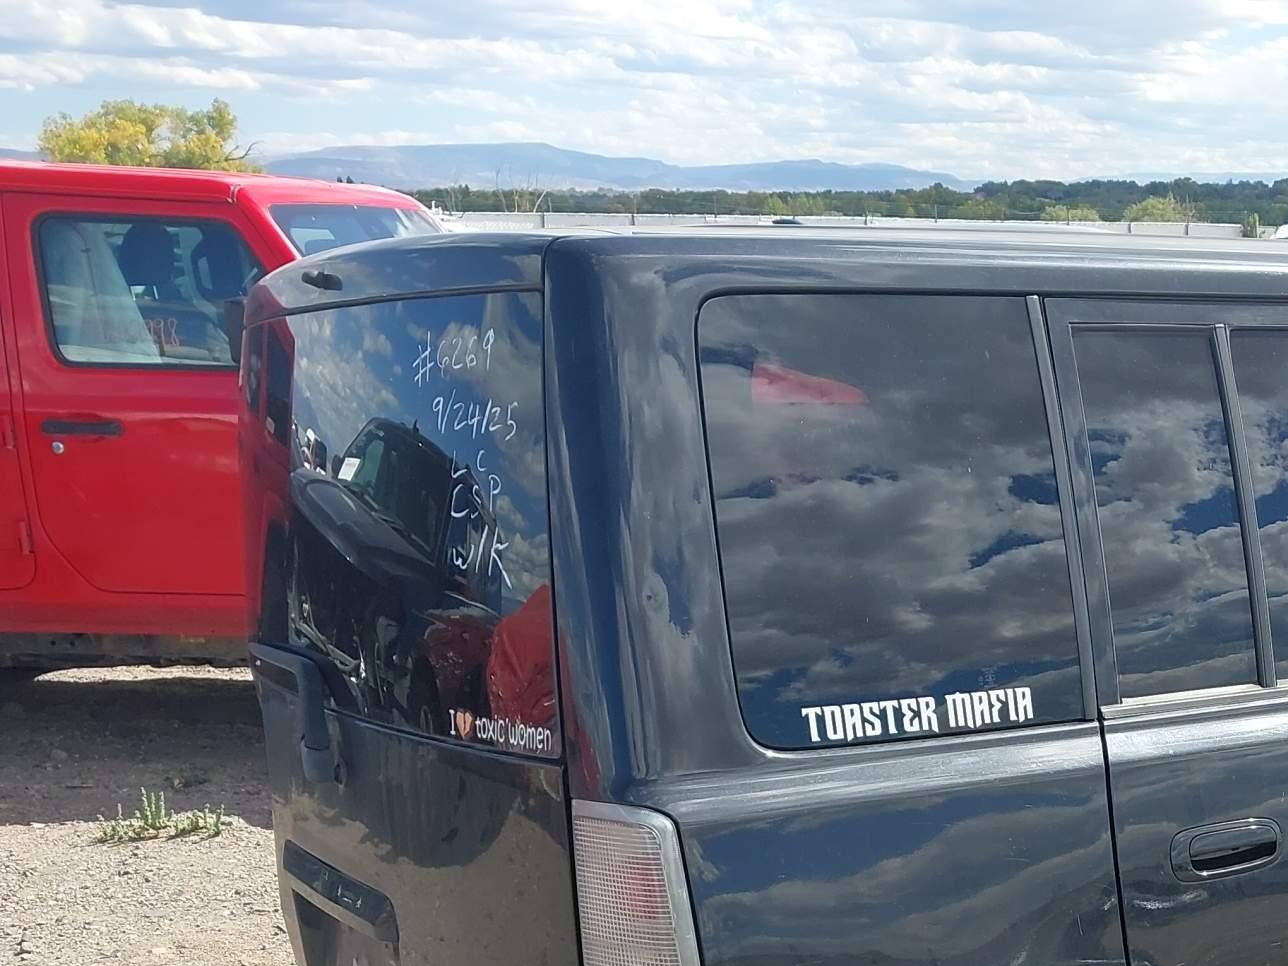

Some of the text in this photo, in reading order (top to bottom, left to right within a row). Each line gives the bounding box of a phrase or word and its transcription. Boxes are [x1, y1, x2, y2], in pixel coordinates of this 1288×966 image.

[412, 327, 495, 388] #6269
[432, 389, 518, 440] 9/24/25
[450, 474, 502, 518] CSP
[448, 709, 552, 751] I toxic women
[801, 687, 1034, 742] TOASTER MAFIA
